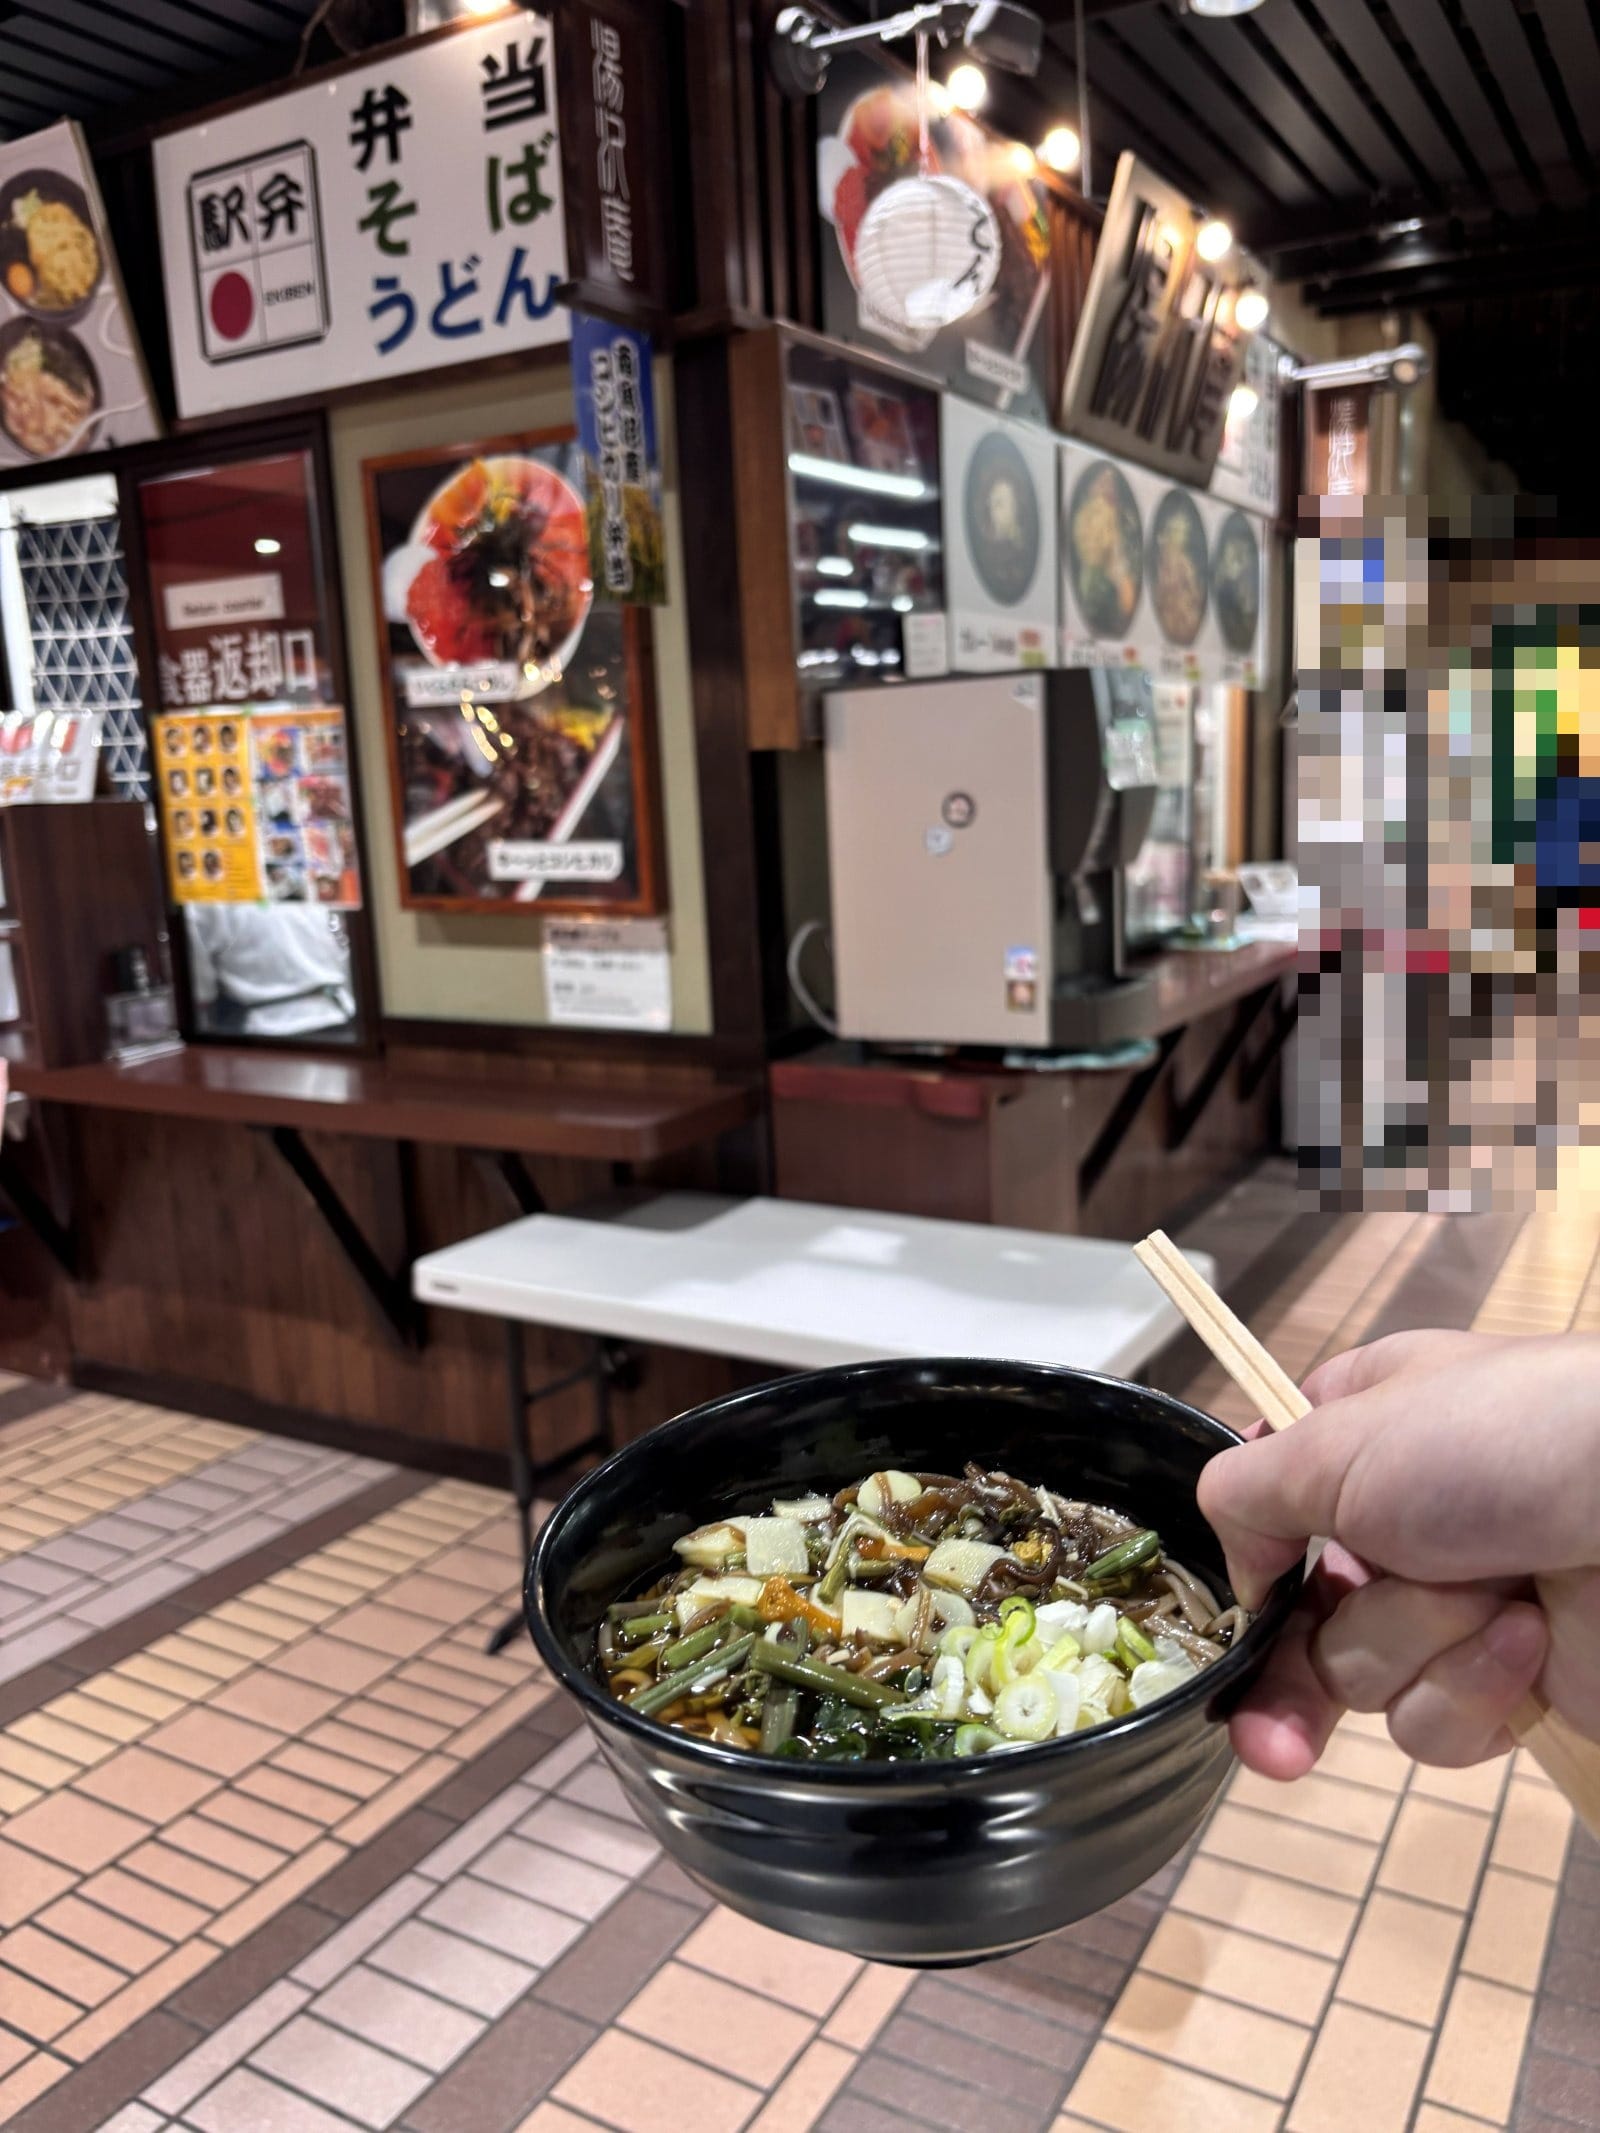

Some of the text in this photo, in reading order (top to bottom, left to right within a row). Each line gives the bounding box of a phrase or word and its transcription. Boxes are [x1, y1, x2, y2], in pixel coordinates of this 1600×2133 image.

[201, 173, 304, 253] 駅弁
[367, 247, 561, 357] うどん
